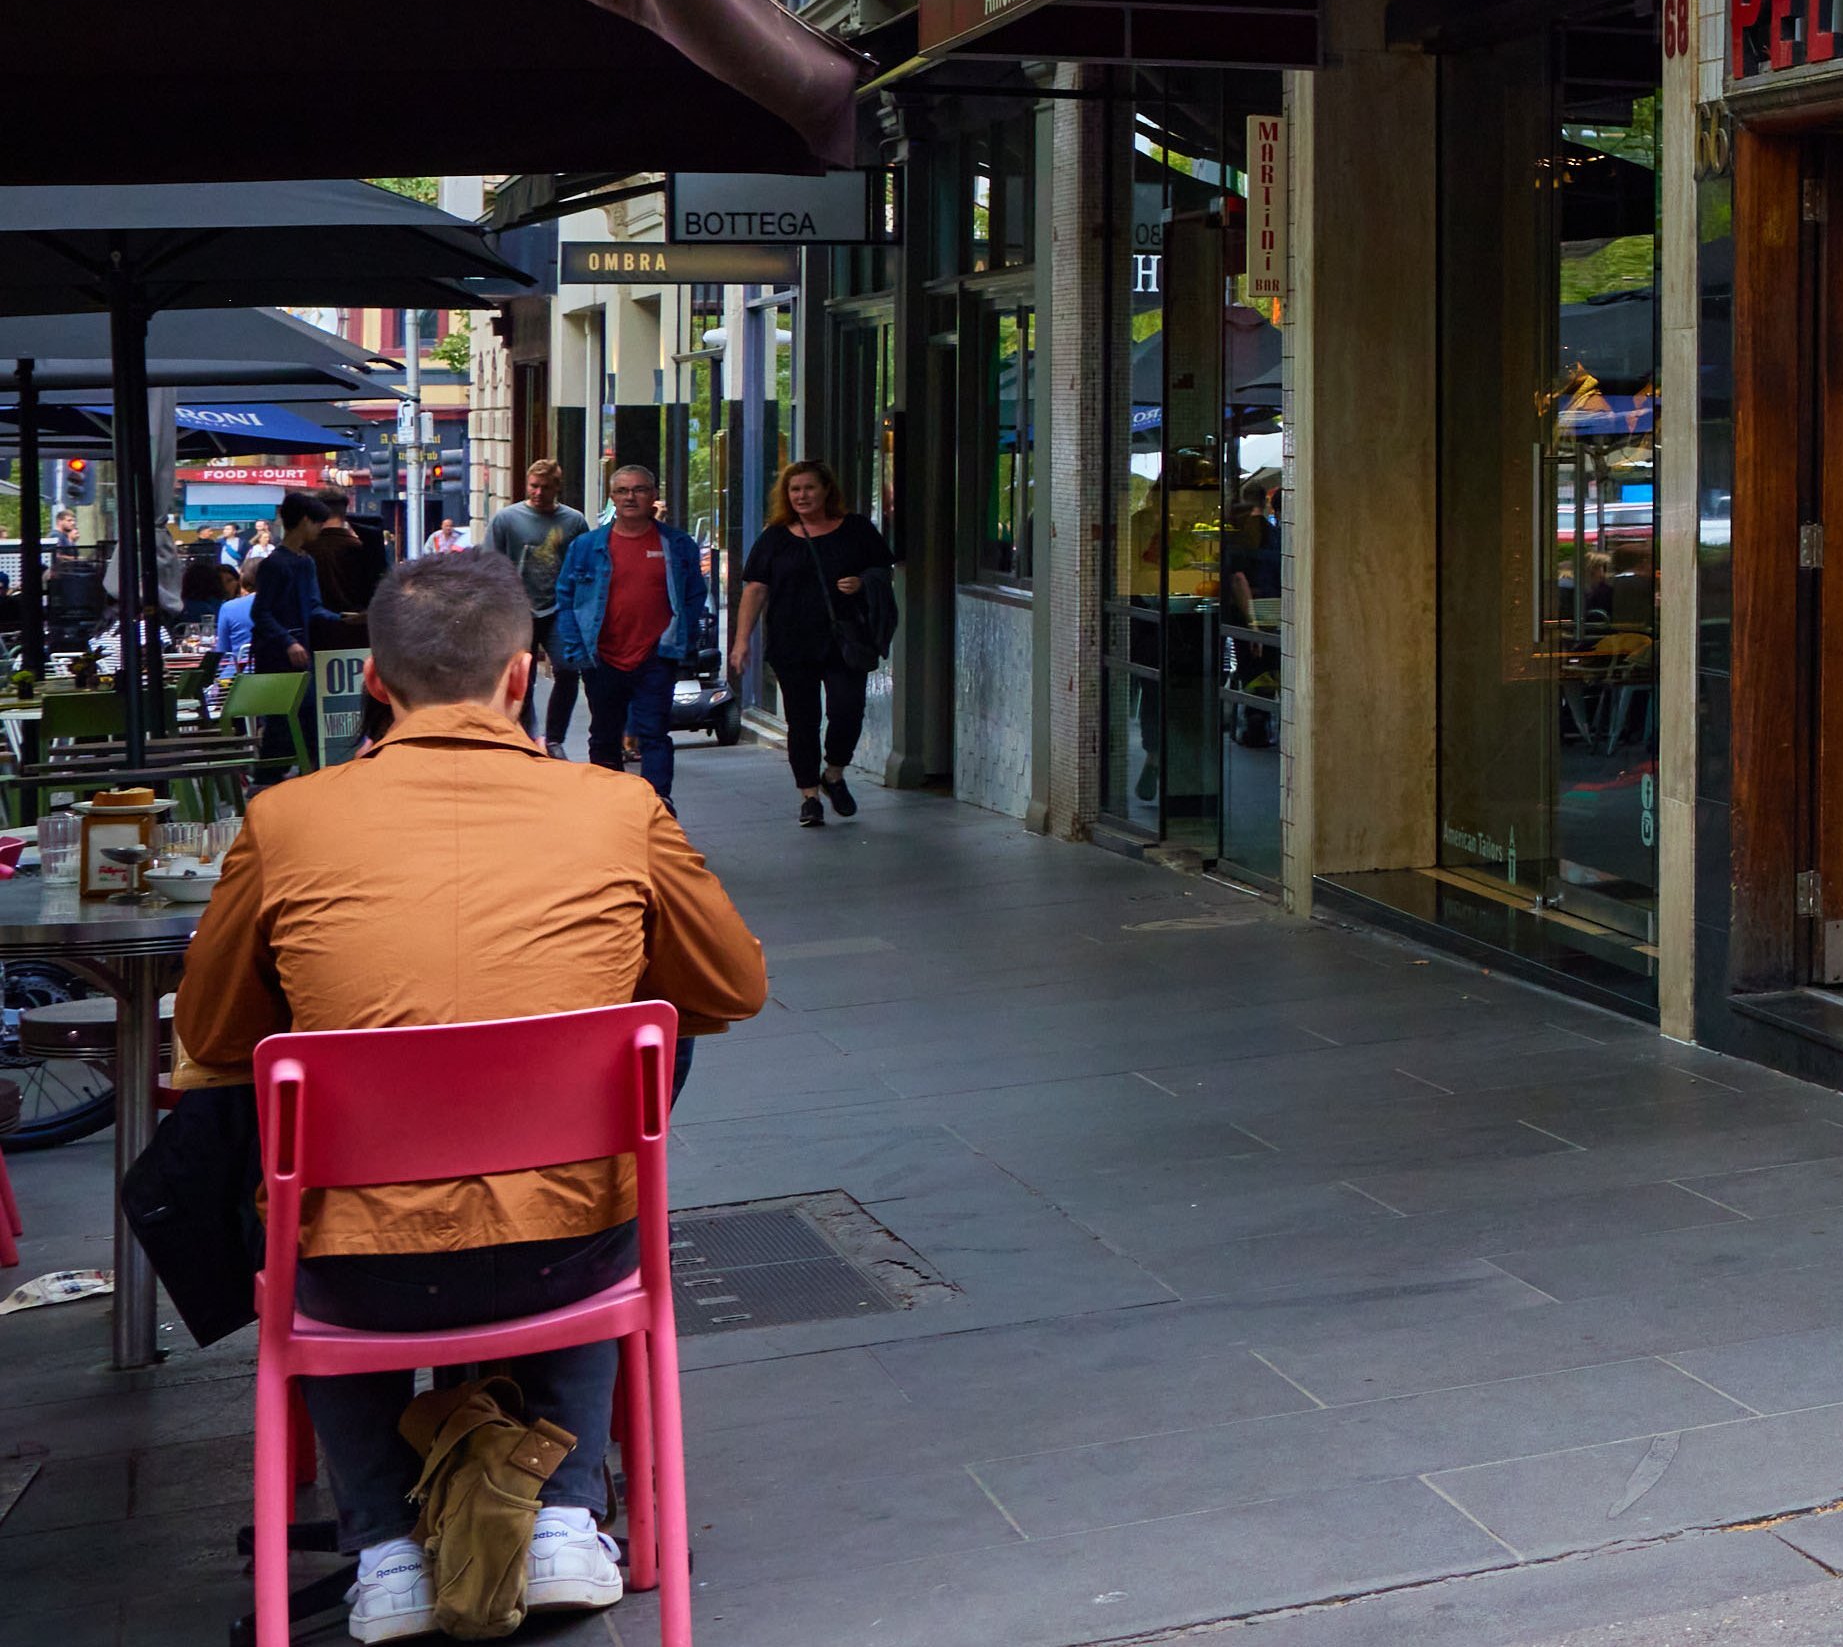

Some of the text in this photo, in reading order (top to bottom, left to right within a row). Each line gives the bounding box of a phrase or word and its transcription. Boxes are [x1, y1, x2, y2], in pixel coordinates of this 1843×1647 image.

[1696, 101, 1729, 179] 66
[685, 212, 817, 237] BOTTEGA
[588, 252, 667, 272] OMBRA
[1255, 278, 1280, 293] BAR
[175, 407, 264, 427] RONI
[203, 470, 248, 480] FOOD
[326, 657, 364, 695] OP
